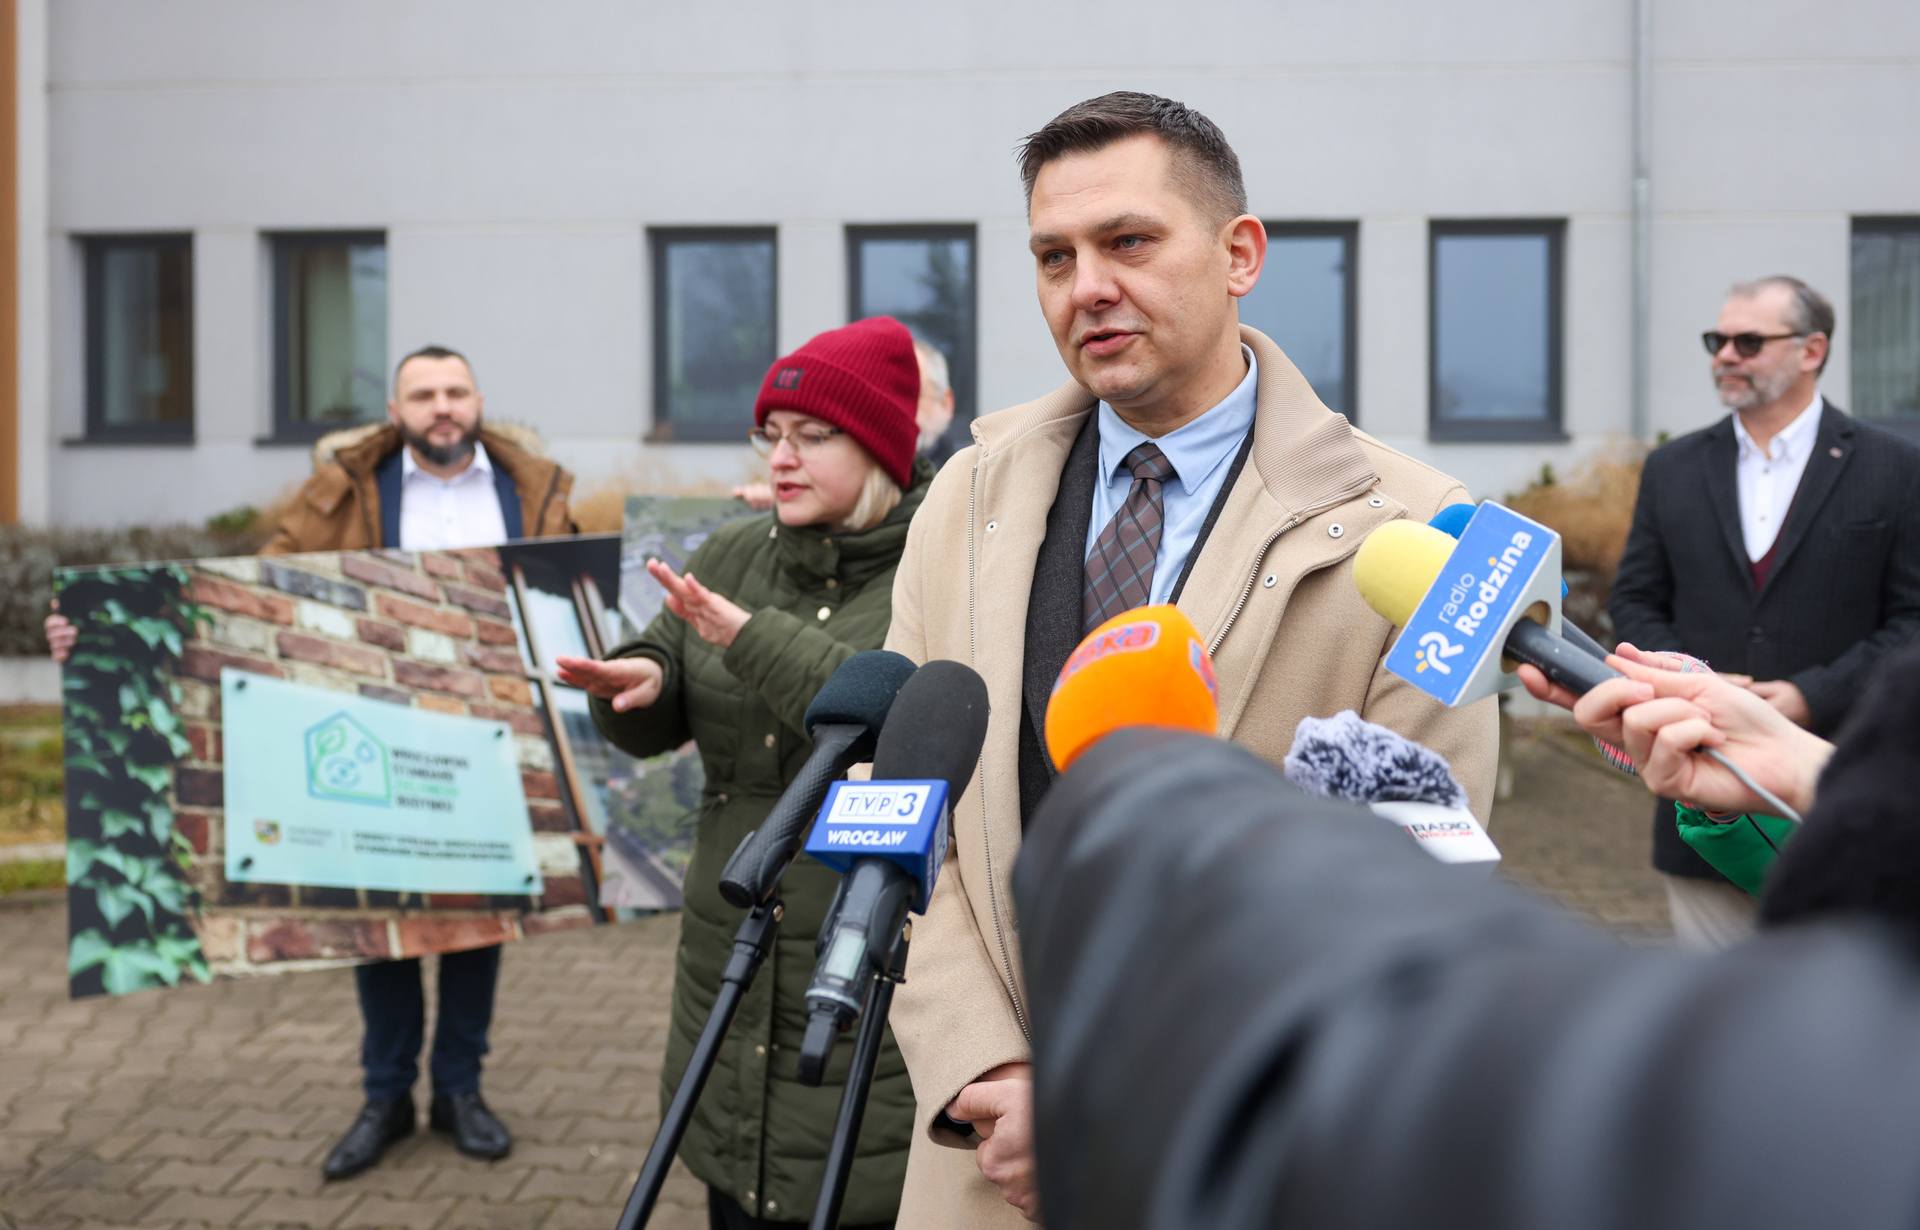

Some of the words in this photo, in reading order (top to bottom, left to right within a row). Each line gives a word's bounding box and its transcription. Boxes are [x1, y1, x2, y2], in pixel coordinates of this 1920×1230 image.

[1454, 531, 1533, 637] Rodzina
[1437, 573, 1475, 624] radio
[847, 796, 892, 812] TVP
[897, 792, 918, 817] 3
[826, 829, 907, 846] WROCŁAW
[1411, 821, 1471, 833] RADIO
